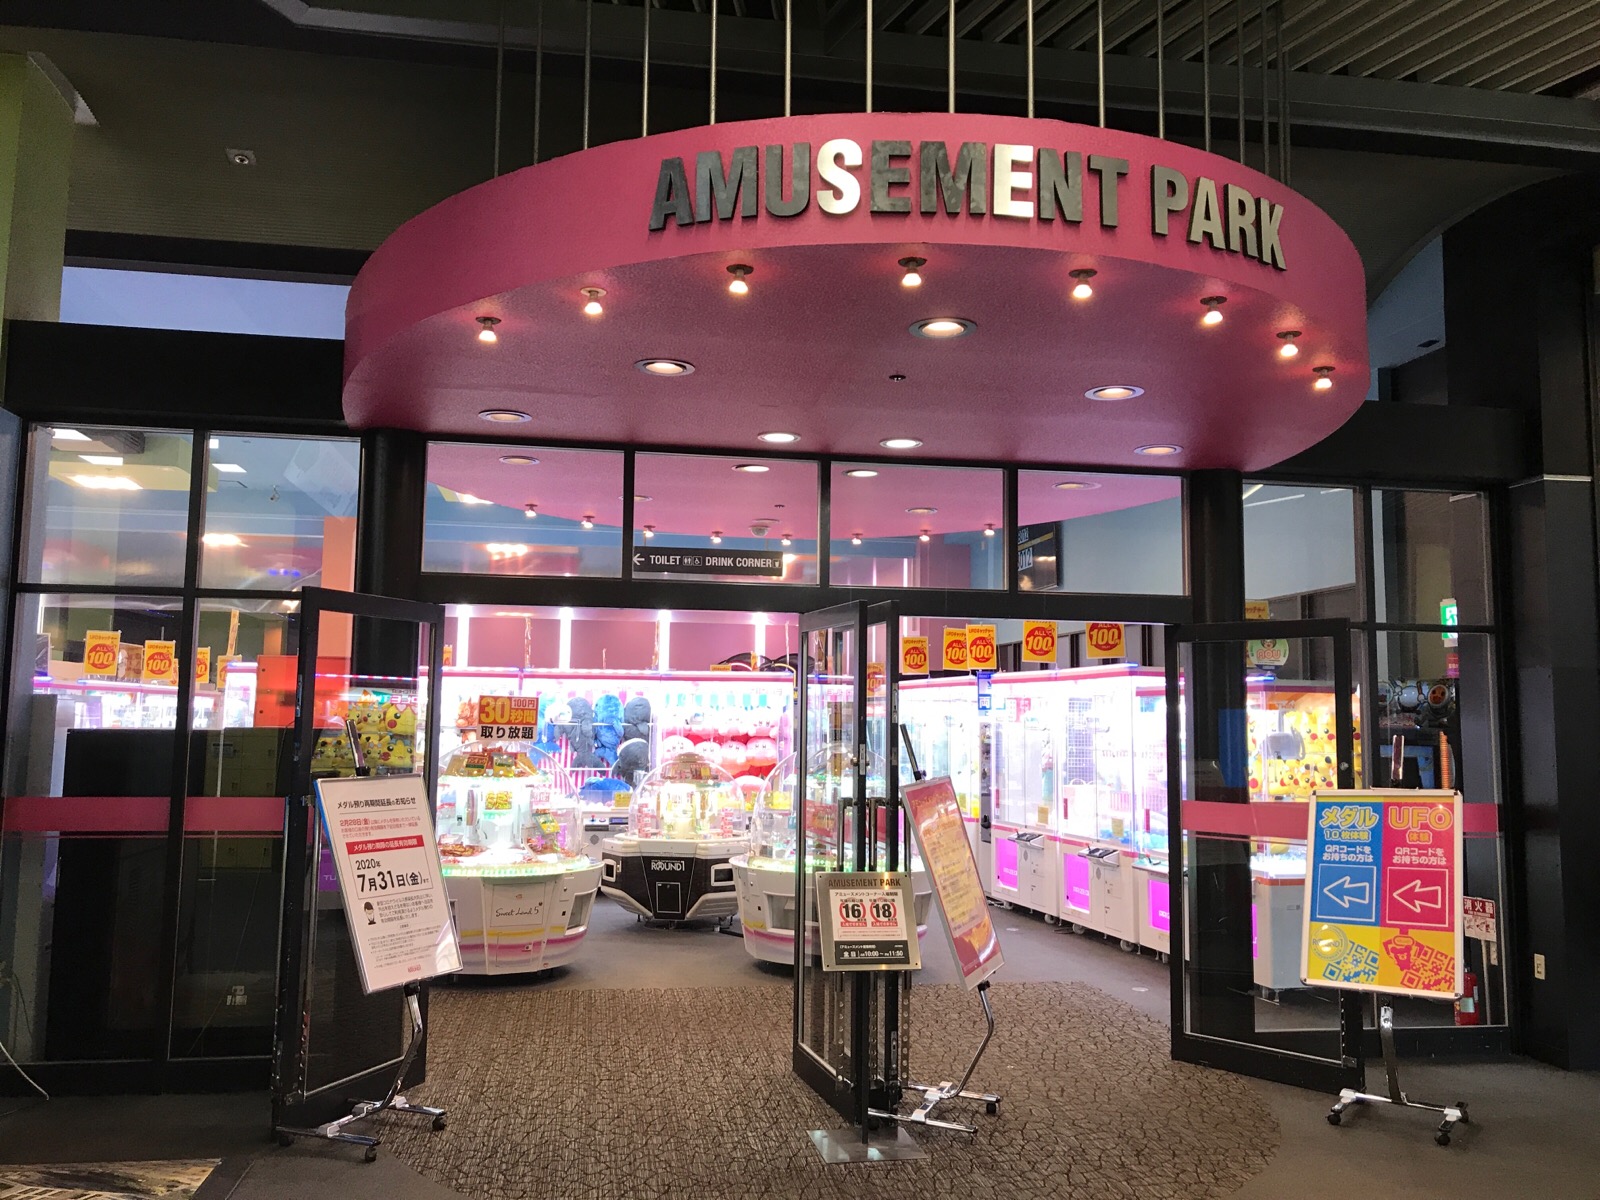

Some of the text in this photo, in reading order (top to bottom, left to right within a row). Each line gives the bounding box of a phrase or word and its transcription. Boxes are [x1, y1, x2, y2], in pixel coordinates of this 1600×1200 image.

[649, 138, 1287, 271] AMUSEMENT PARK
[649, 554, 772, 568] TOILET DRINK CORNER
[480, 696, 510, 724] 30
[513, 698, 535, 708] 100円
[510, 709, 536, 724] 秒間
[480, 725, 534, 740] 取り放題
[1319, 805, 1379, 829] メダル
[1388, 805, 1453, 831] UFO
[1324, 844, 1372, 854] QRコードを
[1394, 846, 1445, 857] QRコードを
[355, 858, 381, 870] 2020年
[1322, 852, 1374, 863] お持ちの方は
[1392, 855, 1447, 865] お持ちの方は
[828, 878, 902, 888] AMUSEMENT PARK
[495, 907, 515, 917] Sweet
[842, 903, 862, 919] 16
[872, 903, 893, 919] 18
[1464, 898, 1494, 914] 消火器
